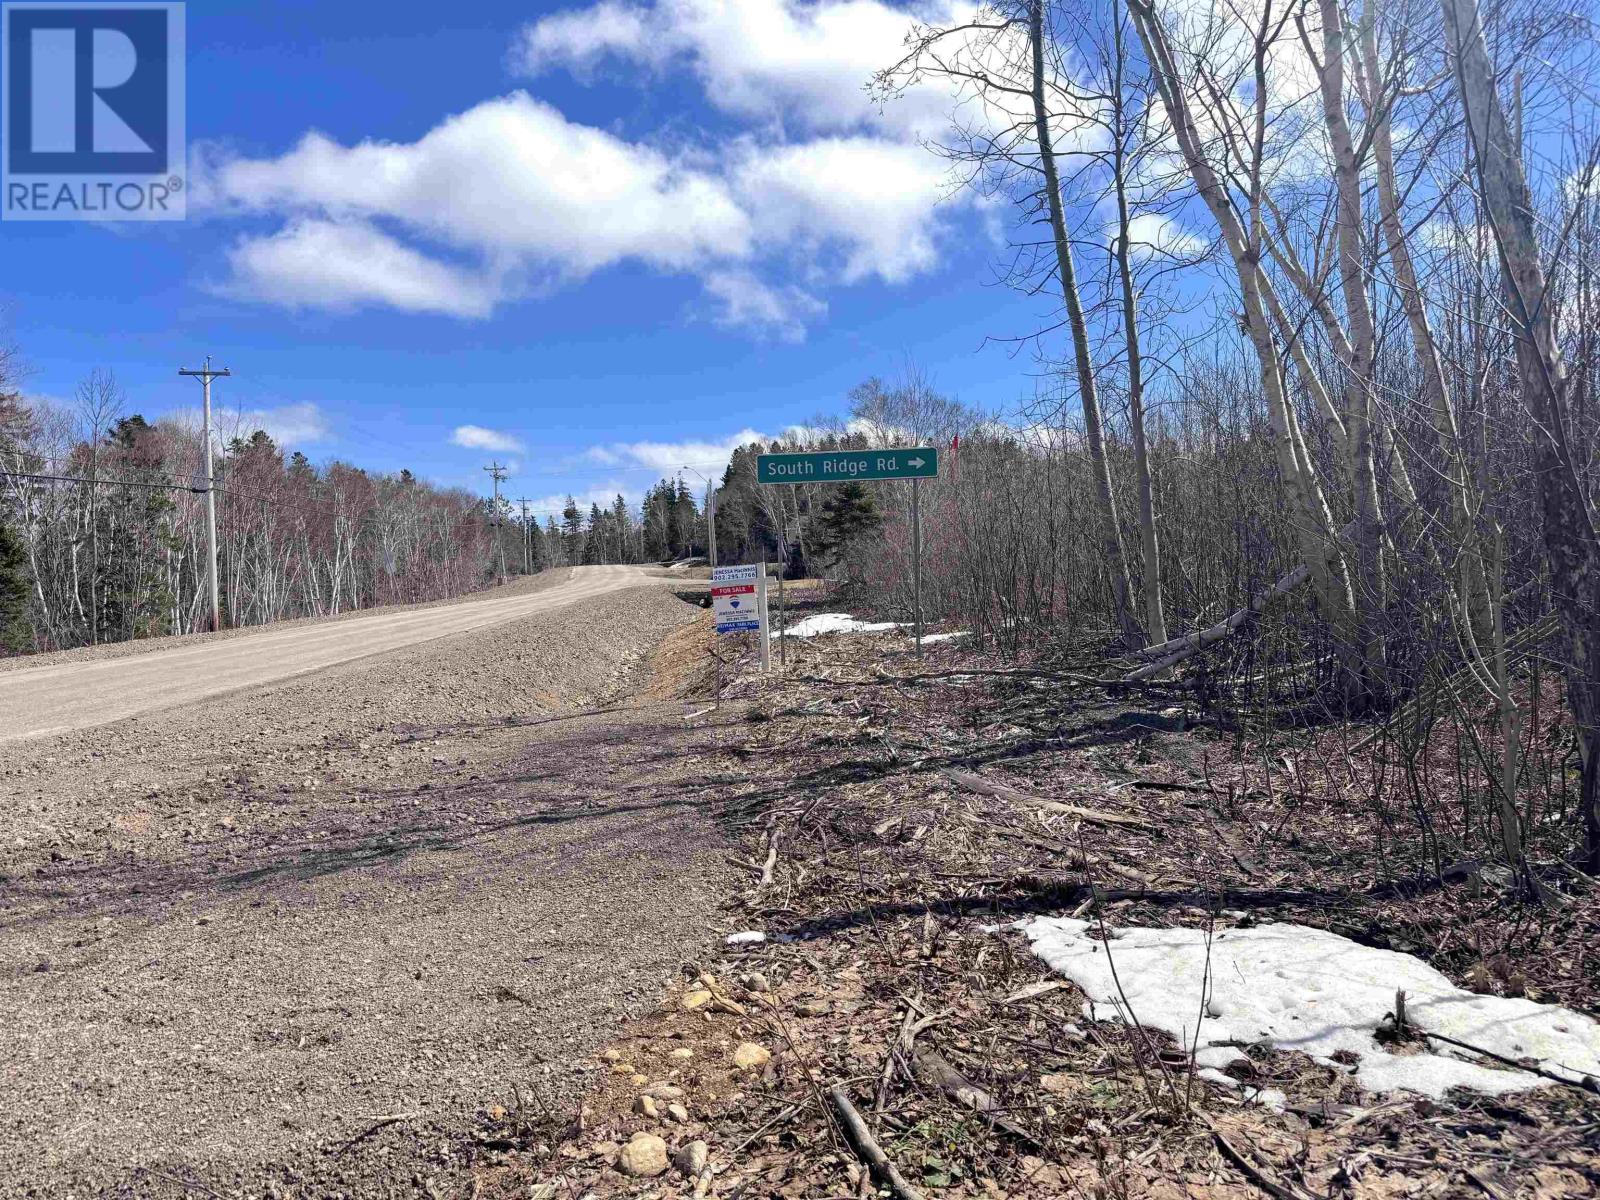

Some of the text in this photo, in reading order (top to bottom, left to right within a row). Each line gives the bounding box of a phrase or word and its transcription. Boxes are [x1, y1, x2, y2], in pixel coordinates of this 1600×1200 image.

[768, 457, 900, 476] South Ridge Rd.
